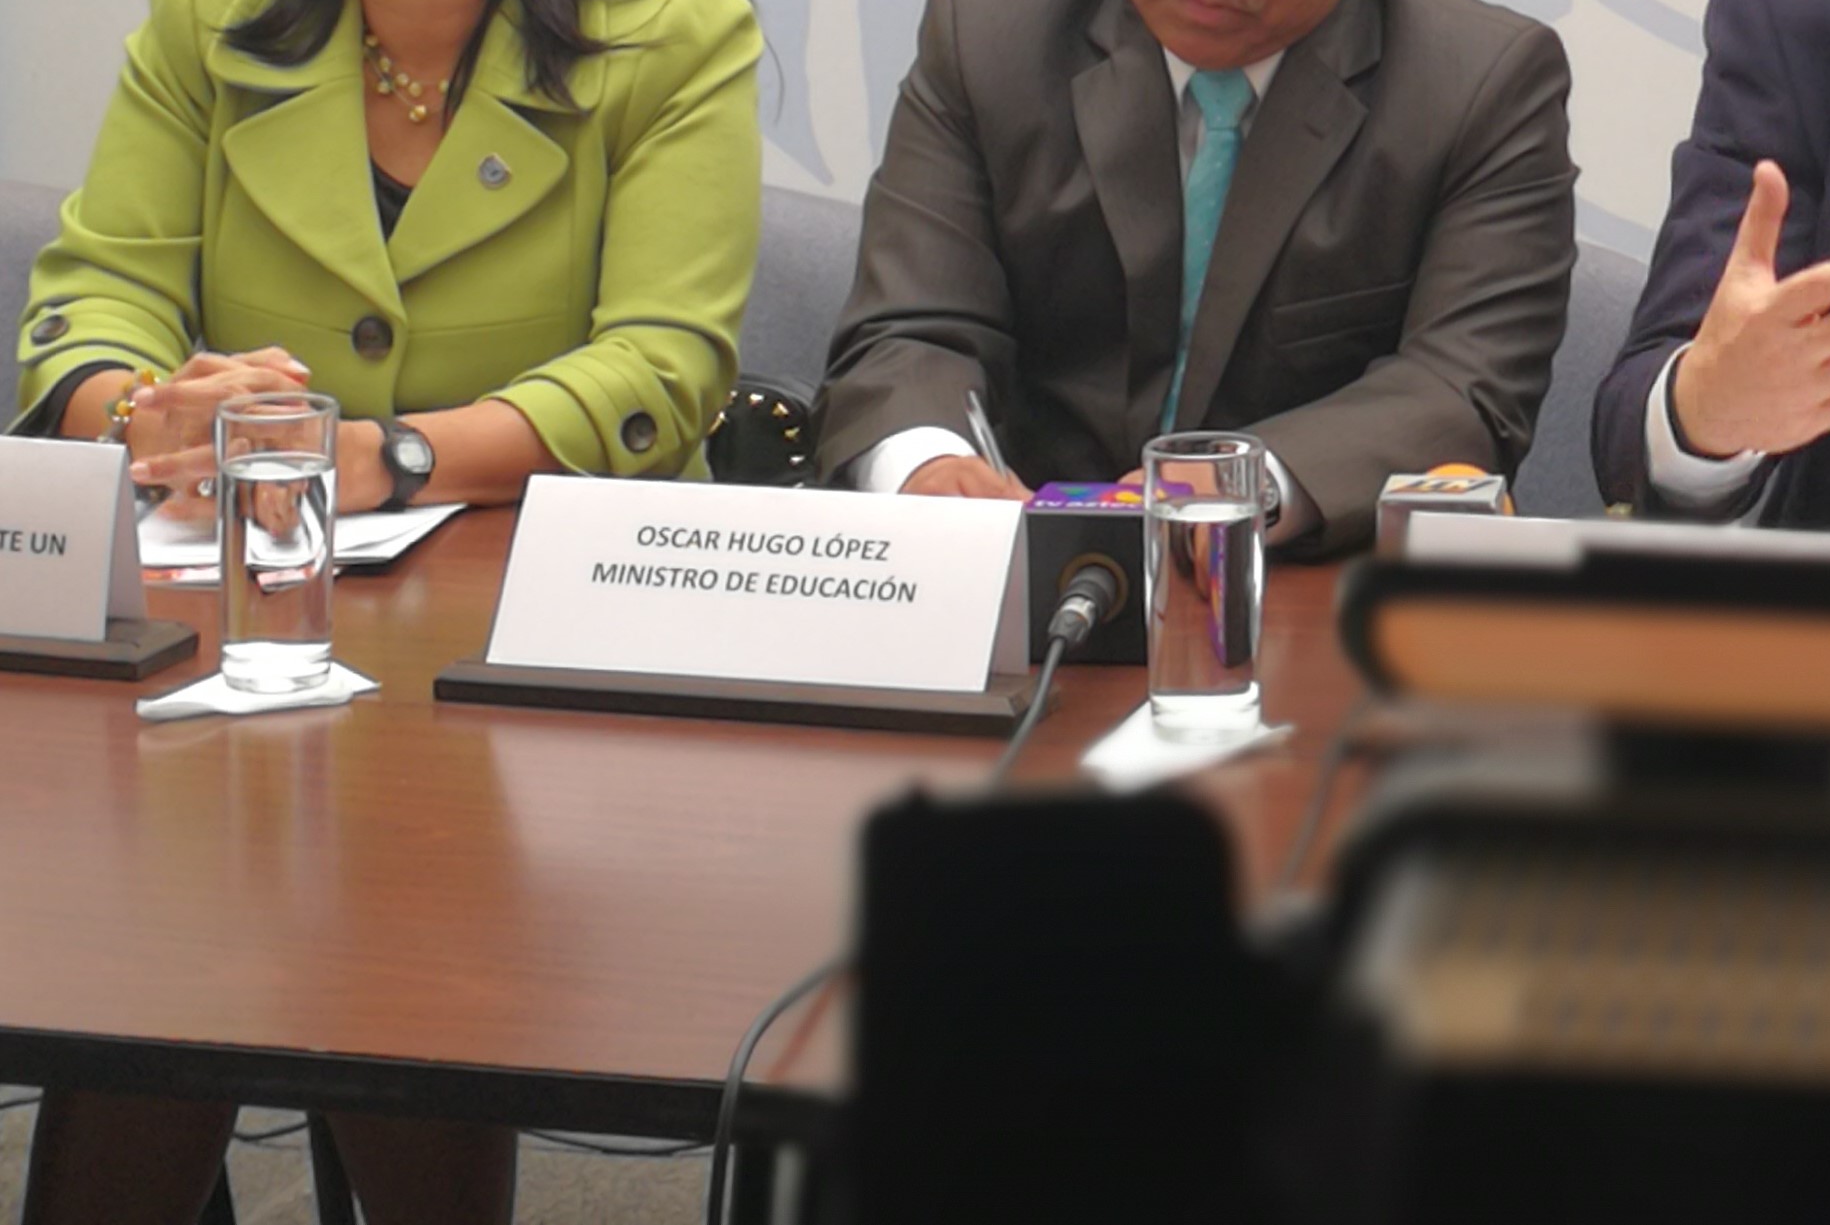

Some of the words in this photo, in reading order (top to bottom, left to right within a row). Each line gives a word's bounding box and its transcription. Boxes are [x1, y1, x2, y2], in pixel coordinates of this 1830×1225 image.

[30, 533, 66, 555] UN
[637, 525, 720, 551] OSCAR
[727, 532, 804, 556] HUGO
[811, 533, 891, 562] LÓPEZ
[592, 563, 718, 590] MINISTRO
[725, 571, 760, 593] DE
[765, 573, 918, 604] EDUCACIÓN
